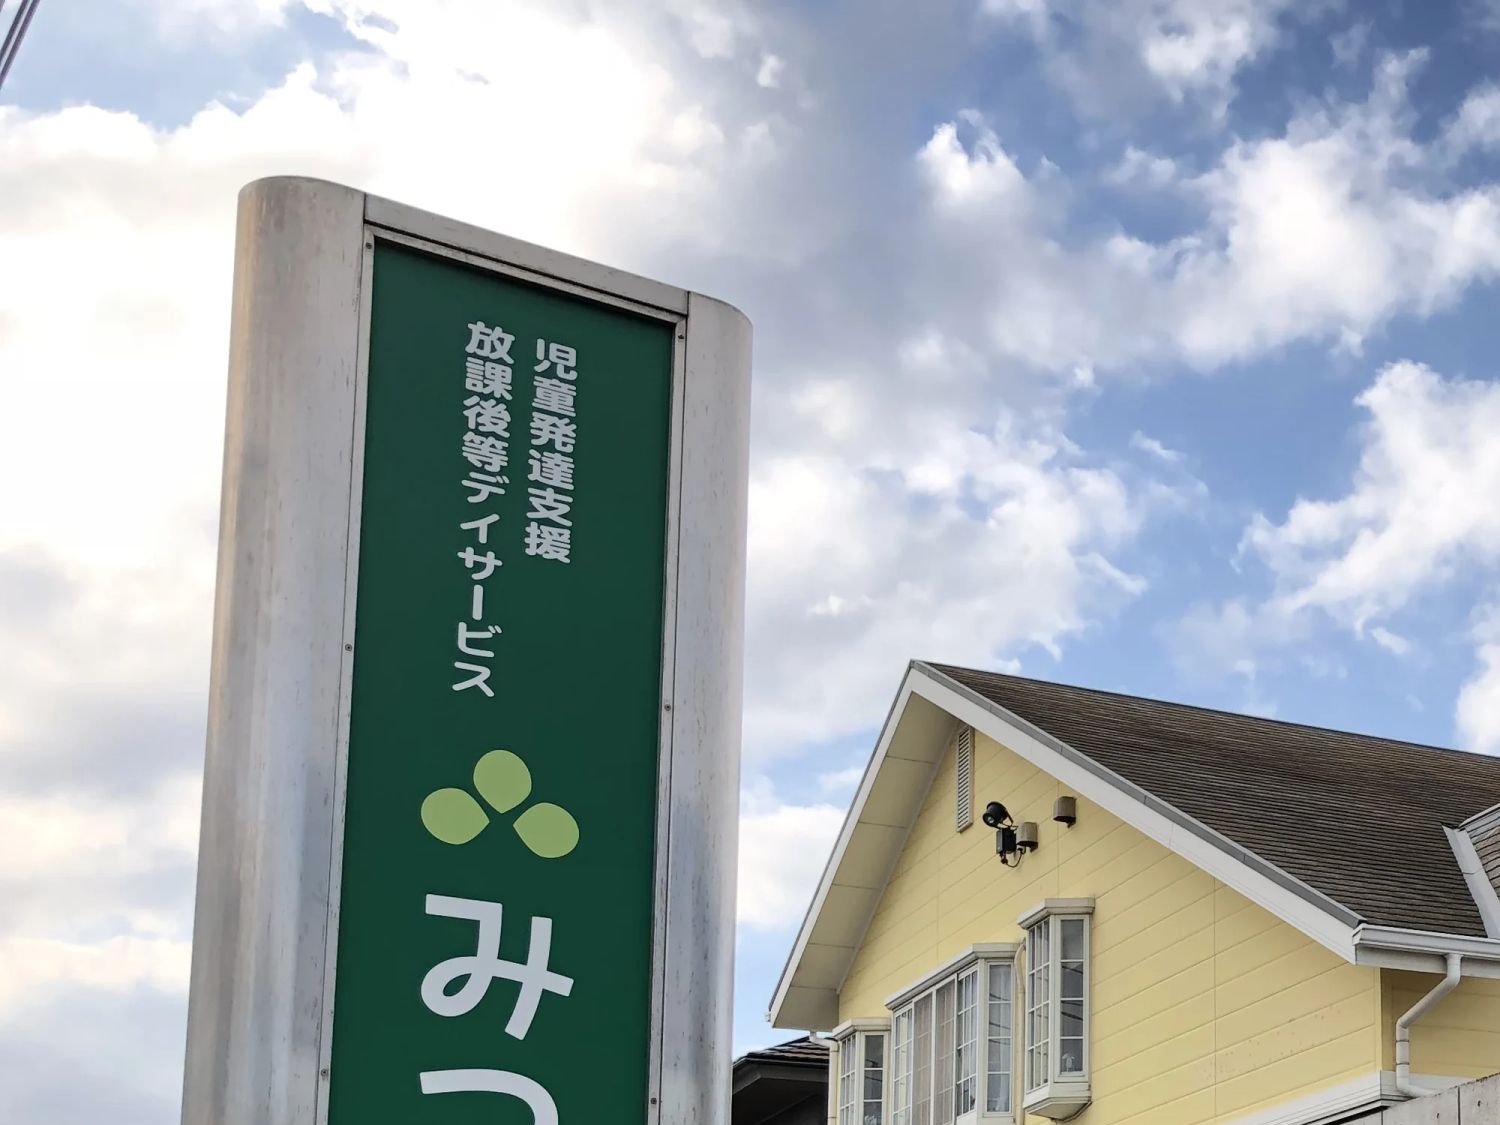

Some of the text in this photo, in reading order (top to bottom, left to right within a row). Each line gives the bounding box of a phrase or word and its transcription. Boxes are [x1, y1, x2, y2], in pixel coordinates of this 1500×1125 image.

[452, 321, 515, 698] 放課後等デイサービス
[525, 338, 577, 564] 児童発達支援
